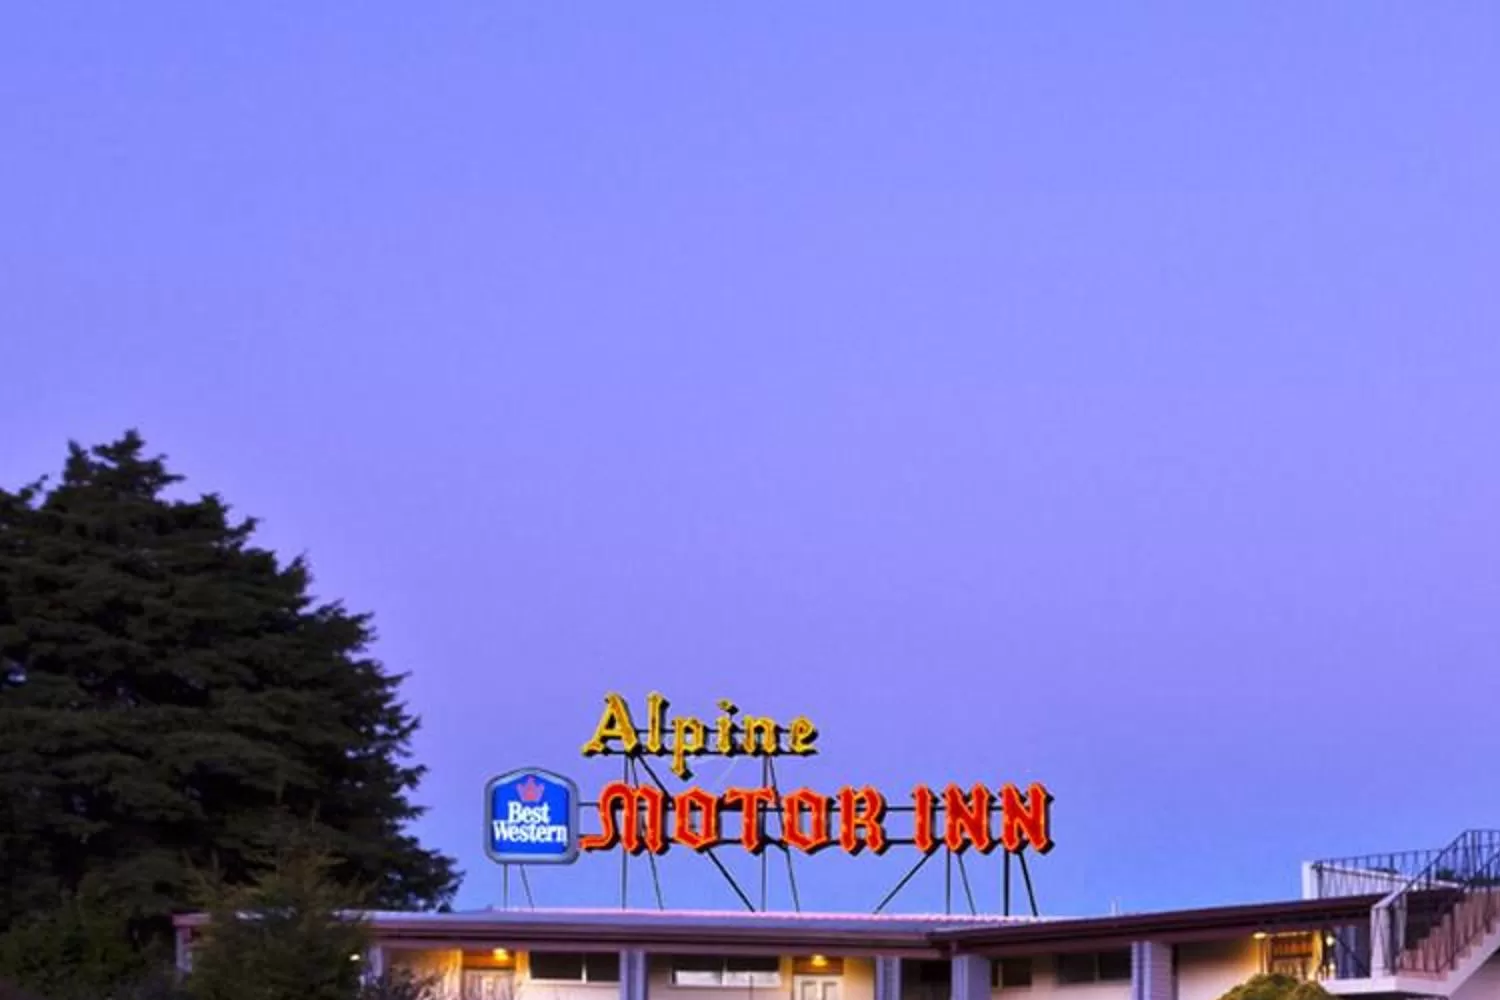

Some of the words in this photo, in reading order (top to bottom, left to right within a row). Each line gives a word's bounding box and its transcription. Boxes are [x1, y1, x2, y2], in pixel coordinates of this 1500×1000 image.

[581, 692, 818, 780] Alpine
[493, 820, 568, 846] Western
[507, 801, 550, 824] Best
[579, 782, 888, 856] MOTOR
[911, 782, 1055, 855] INN
